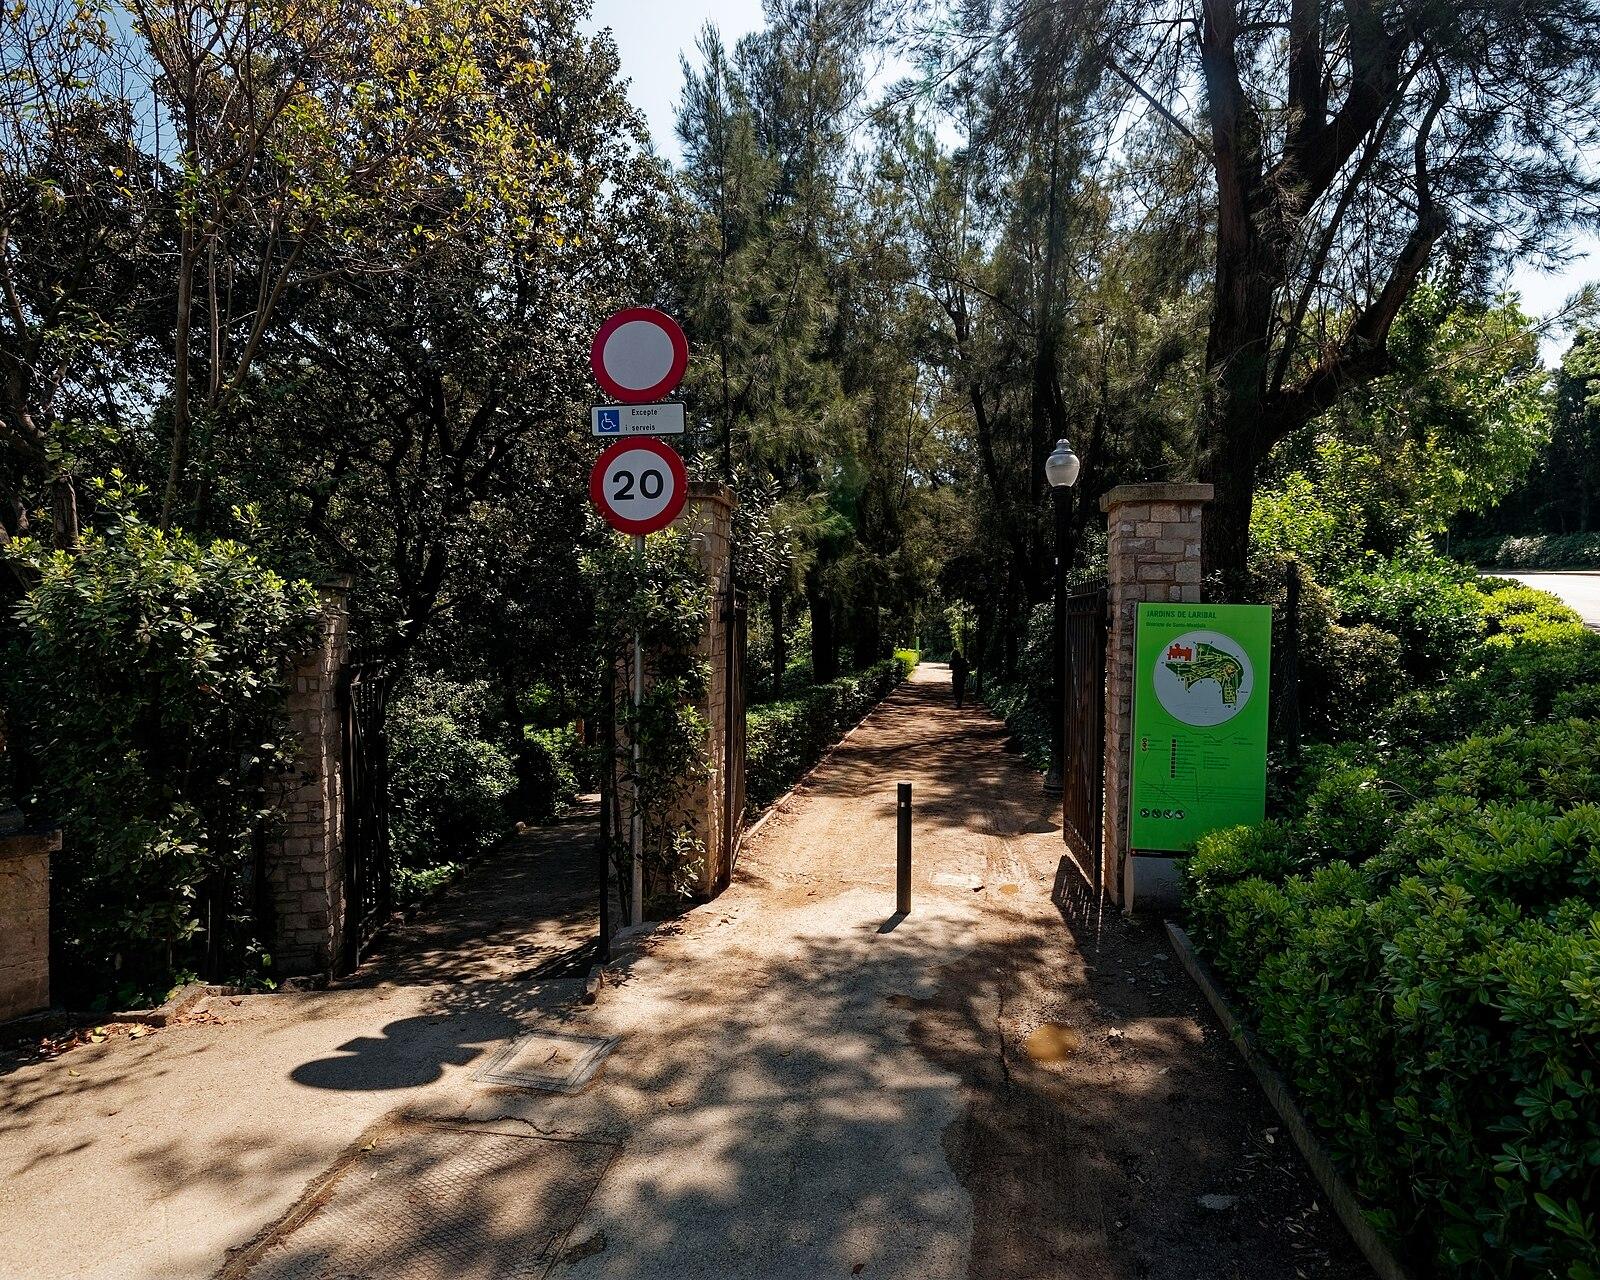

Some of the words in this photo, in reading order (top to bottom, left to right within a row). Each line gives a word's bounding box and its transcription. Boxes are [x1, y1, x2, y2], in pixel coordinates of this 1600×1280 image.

[631, 408, 658, 416] Excepte
[631, 423, 656, 431] serveis
[612, 469, 664, 501] 20
[1146, 610, 1176, 618] JARDINS
